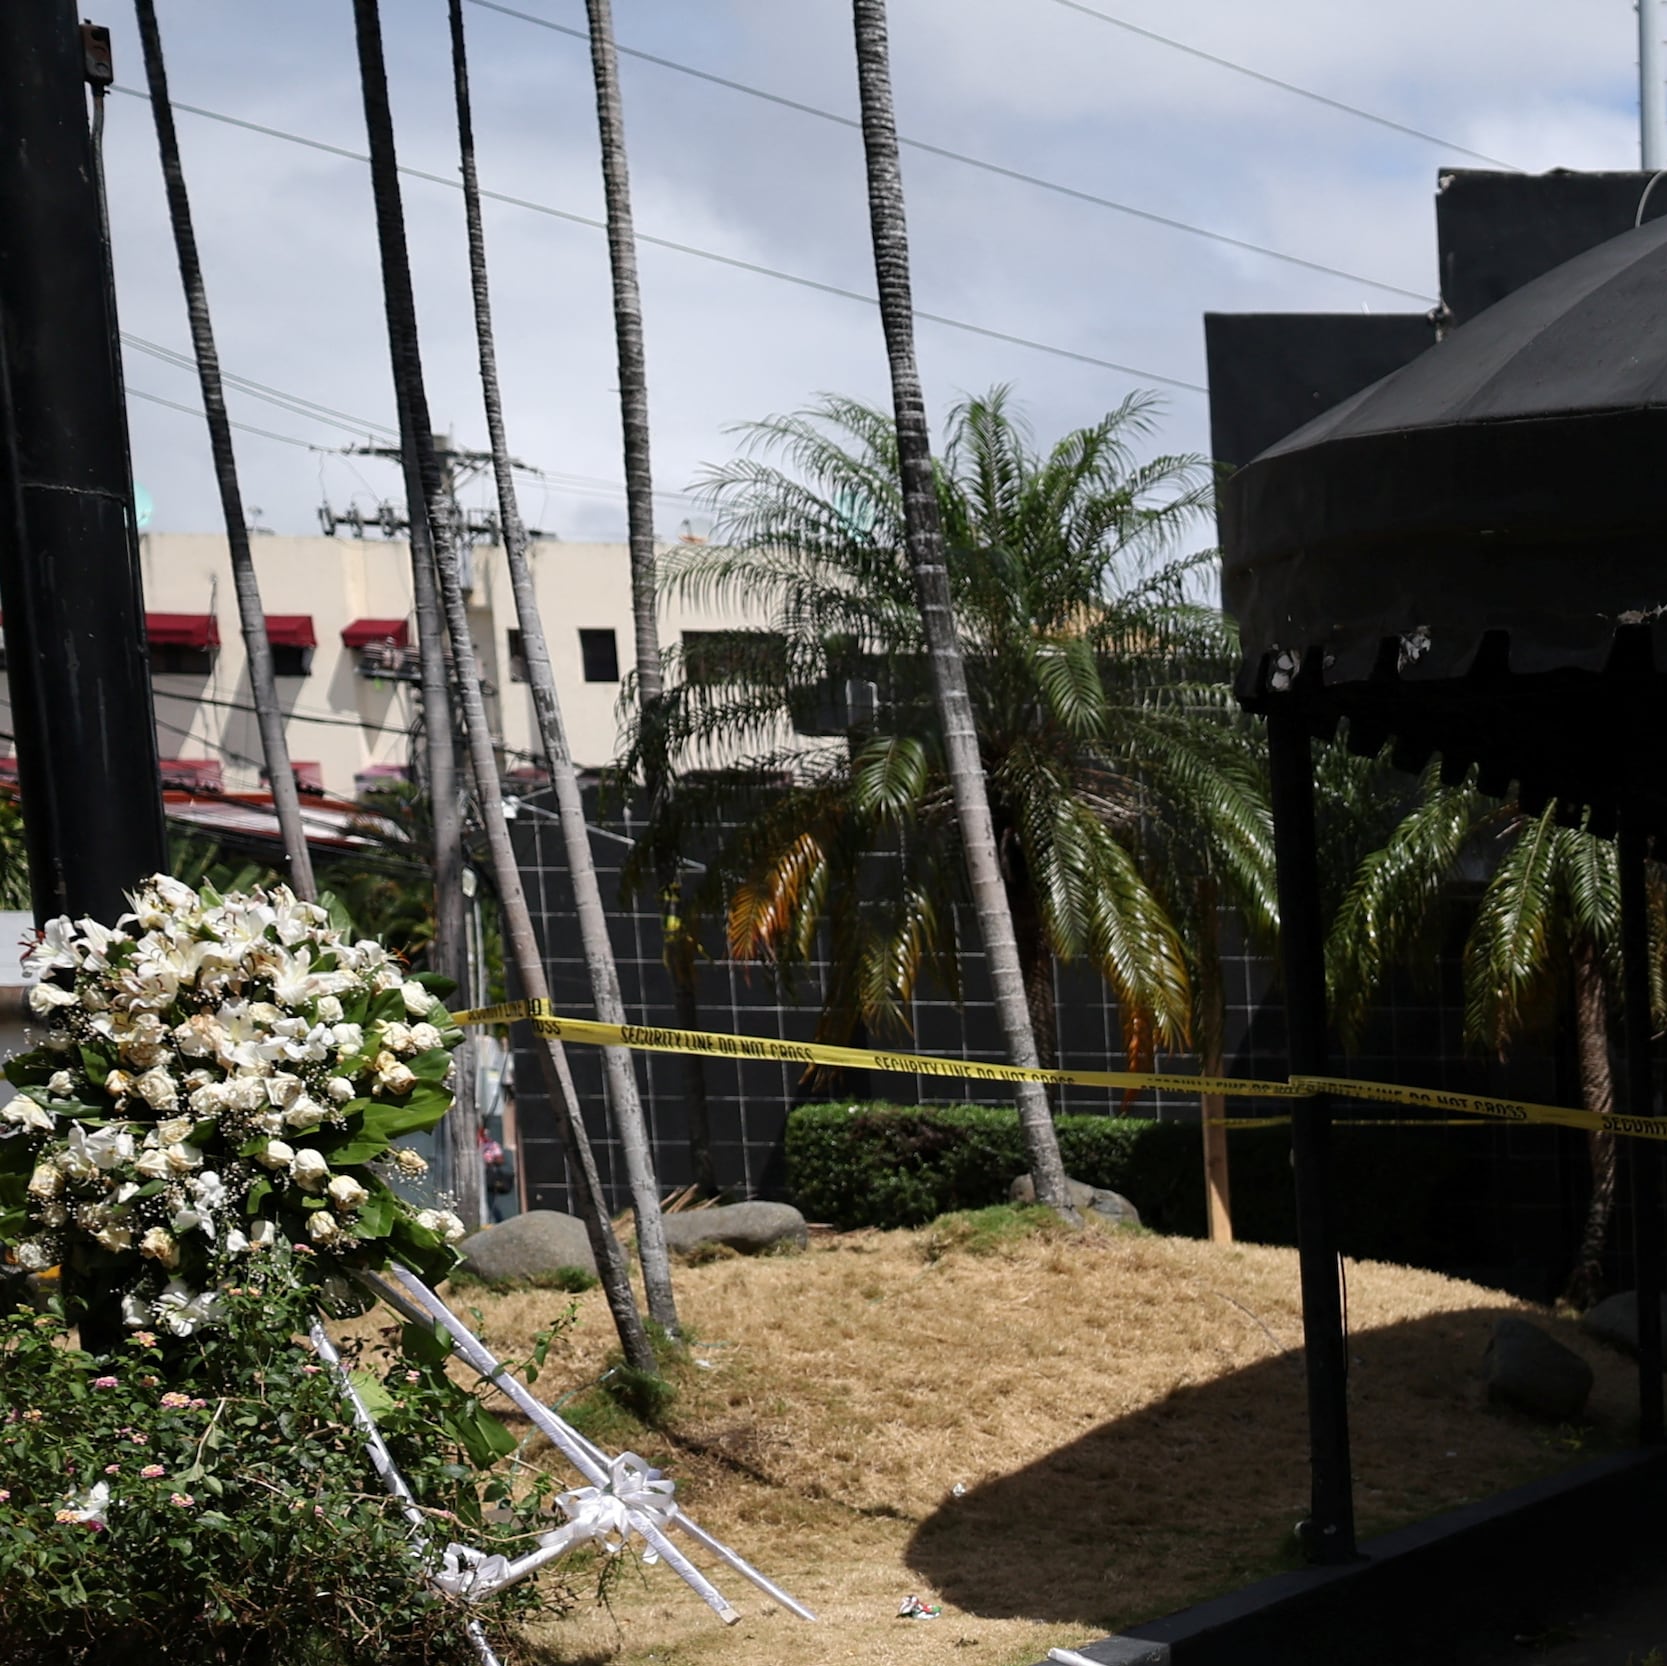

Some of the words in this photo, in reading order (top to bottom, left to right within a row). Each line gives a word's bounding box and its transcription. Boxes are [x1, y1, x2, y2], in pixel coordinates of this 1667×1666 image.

[620, 1025, 683, 1050] SECURITY
[685, 1033, 713, 1052] LINE
[718, 1036, 737, 1055] DO
[740, 1039, 767, 1058] NOT
[770, 1043, 814, 1063] CROSS
[873, 1055, 938, 1077] SECURITY
[940, 1061, 972, 1079] LINE
[1474, 1101, 1528, 1120] CROSS
